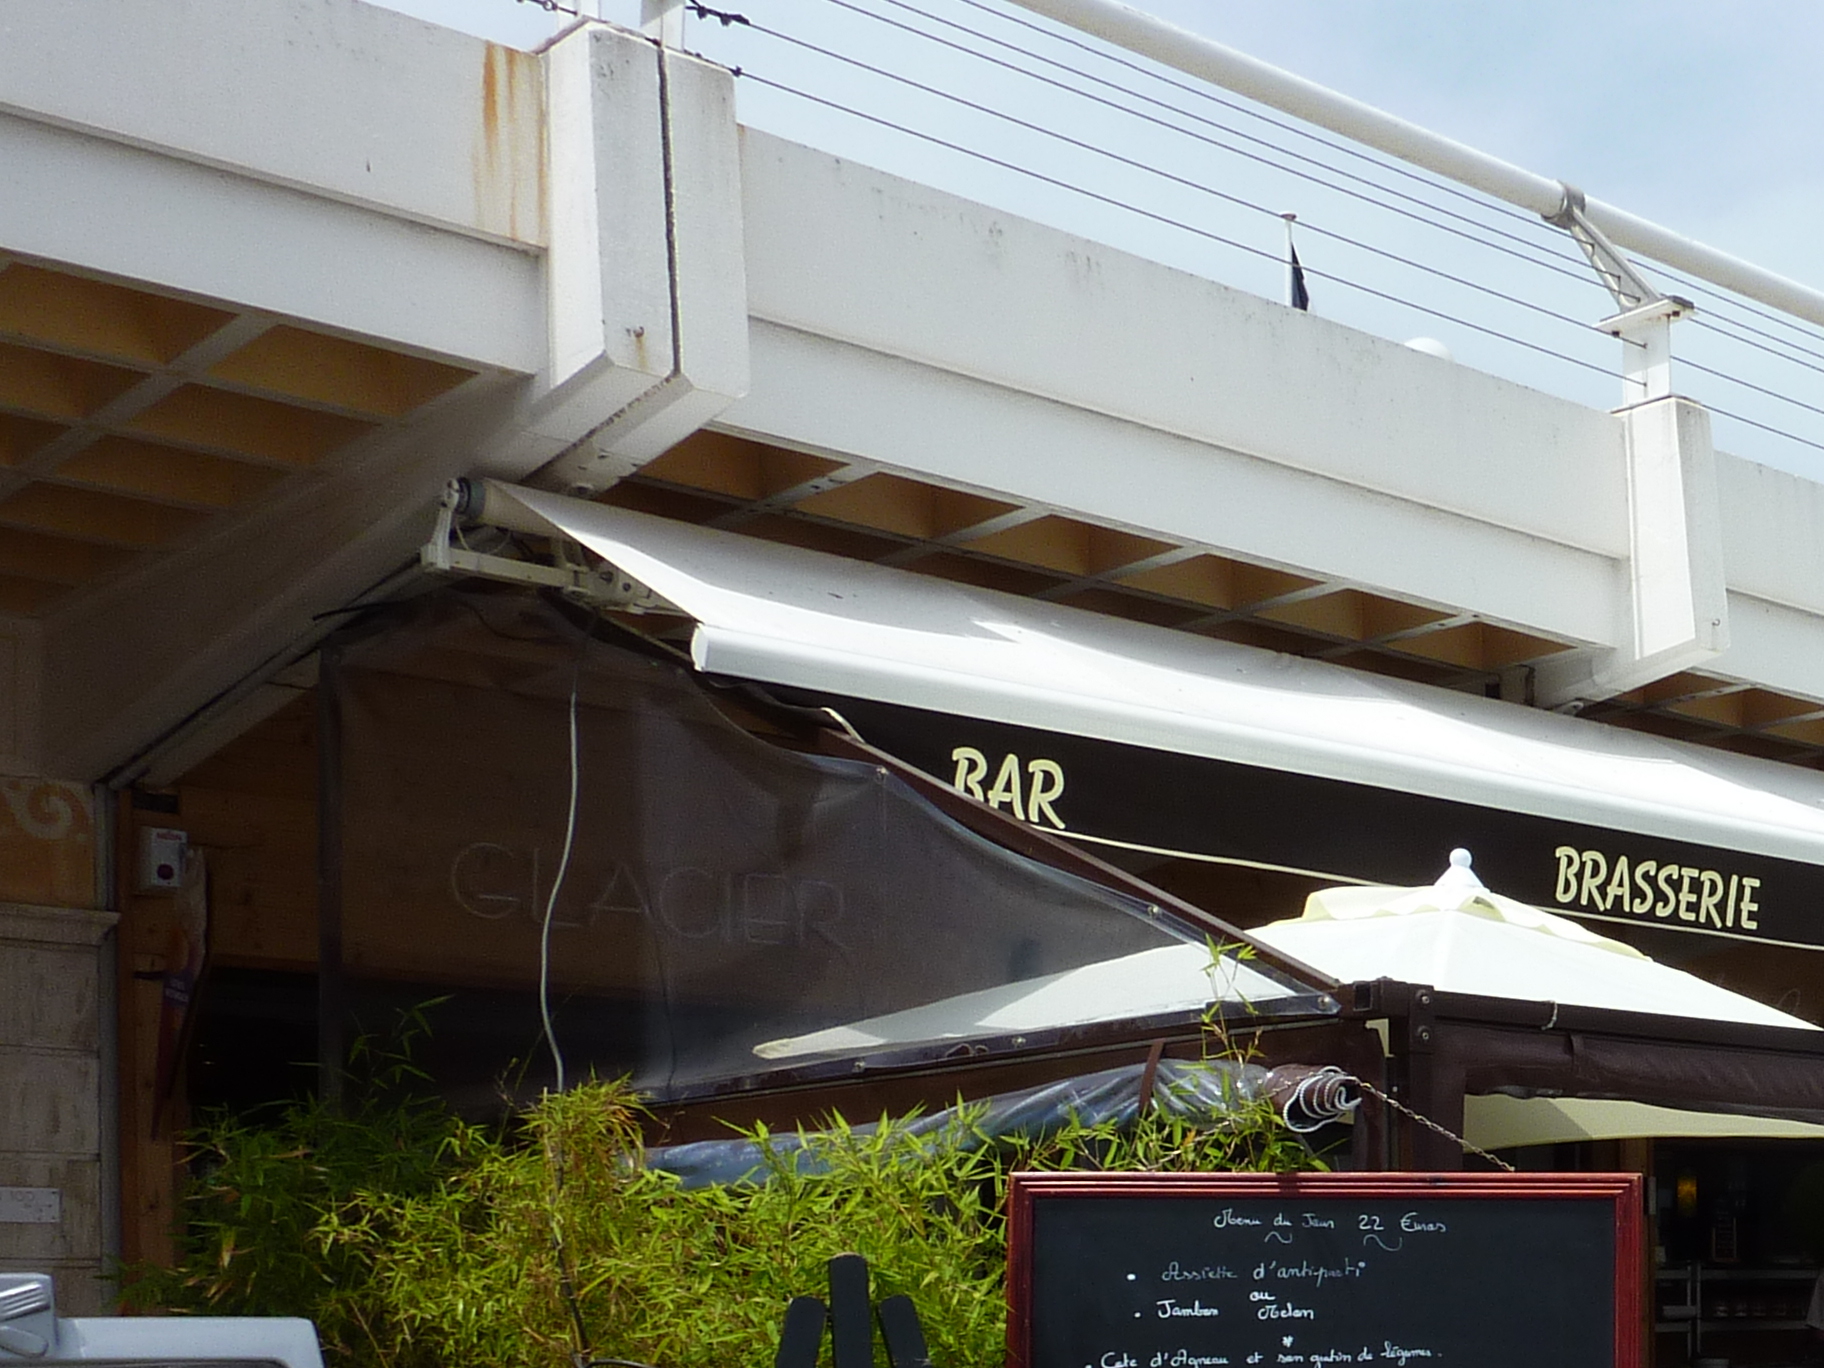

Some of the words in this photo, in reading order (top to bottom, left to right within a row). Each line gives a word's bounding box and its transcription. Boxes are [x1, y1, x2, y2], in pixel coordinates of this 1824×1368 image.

[951, 745, 1067, 830] BAR
[1554, 844, 1762, 932] BRASSERIE
[1214, 1208, 1262, 1228] Menu
[1273, 1213, 1292, 1226] du
[1301, 1213, 1335, 1229] Jour
[1358, 1214, 1385, 1231] 22
[1161, 1261, 1238, 1281] Assiette
[1249, 1290, 1276, 1301] ou
[1157, 1299, 1219, 1319] Jambon
[1257, 1303, 1314, 1321] Melon
[1246, 1353, 1263, 1364] et
[1277, 1353, 1304, 1363] son
[1357, 1347, 1373, 1362] de
